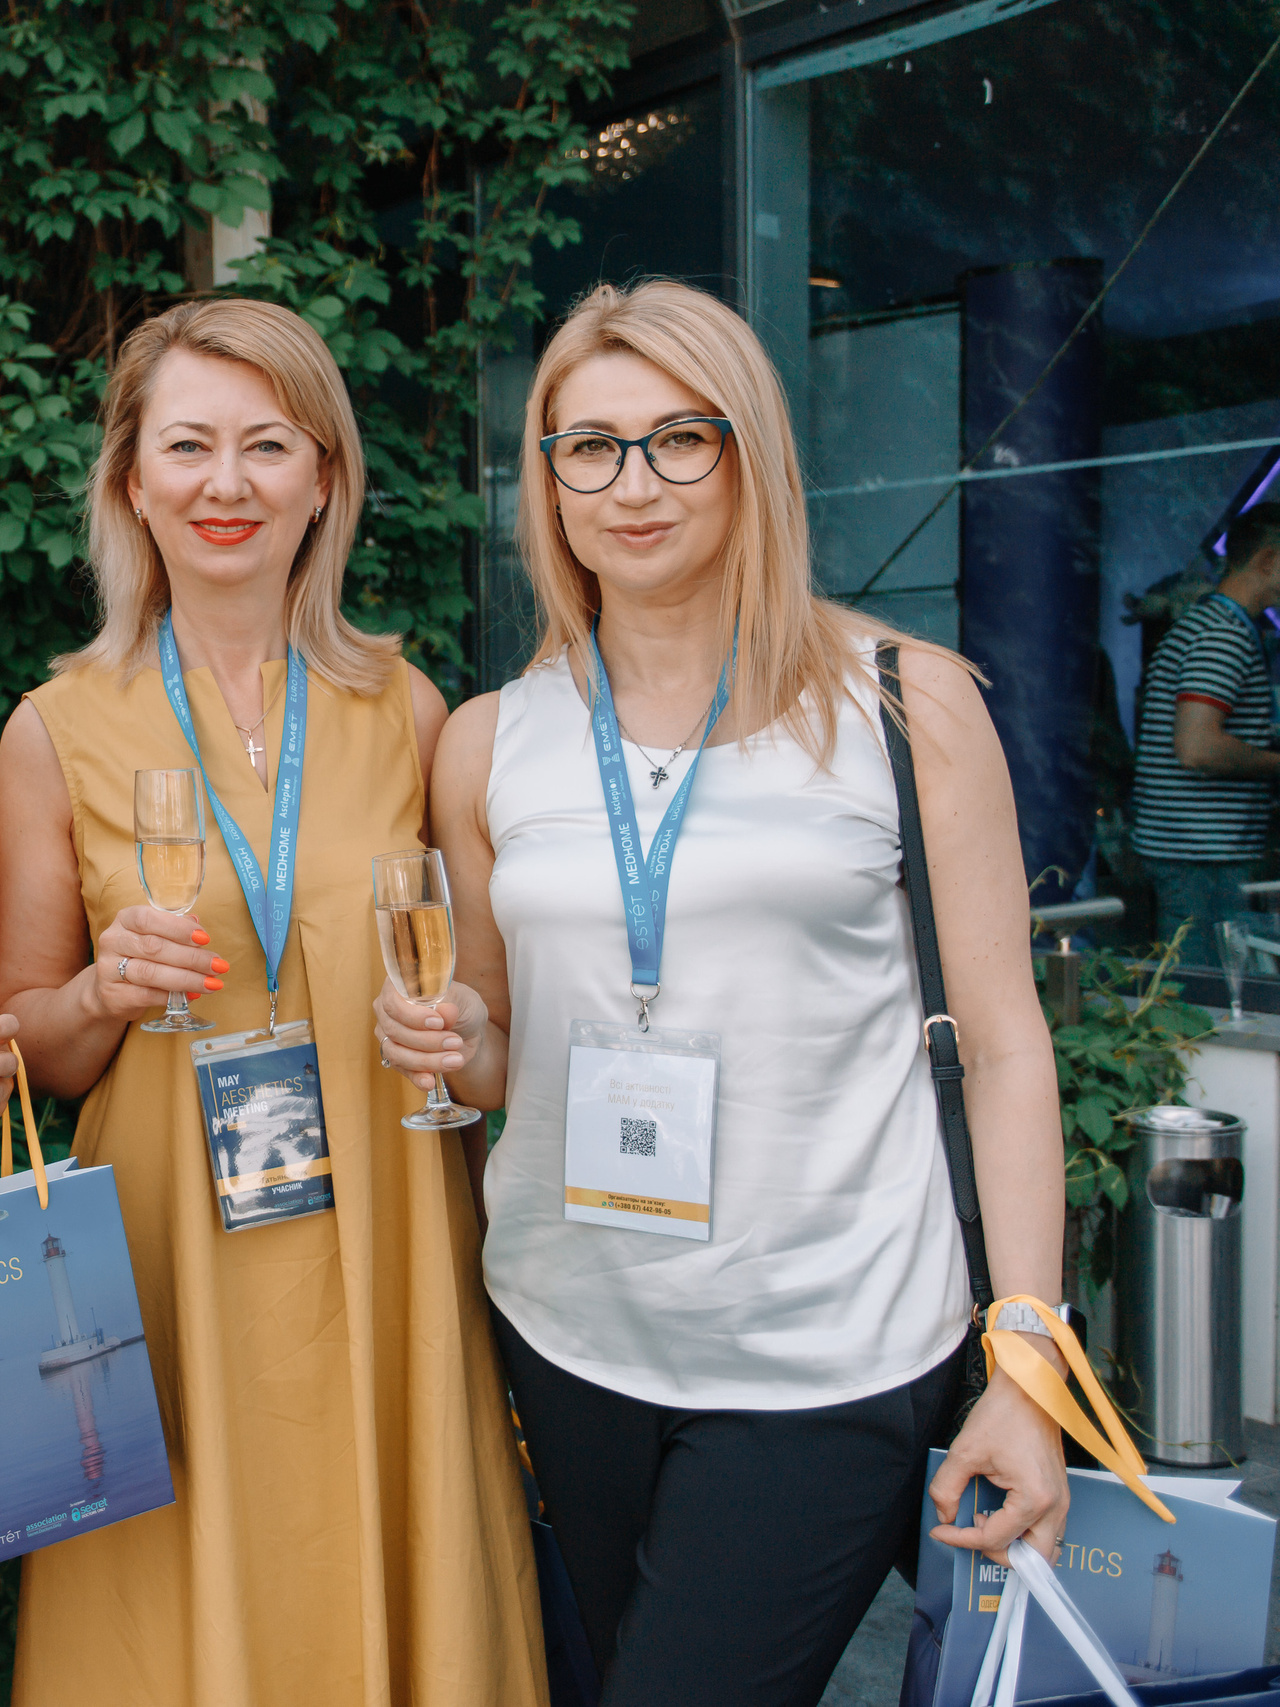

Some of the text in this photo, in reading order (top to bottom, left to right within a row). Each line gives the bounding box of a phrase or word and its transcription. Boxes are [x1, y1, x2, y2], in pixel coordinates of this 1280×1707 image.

[290, 680, 298, 702] EURO
[279, 778, 291, 818] Asclepion
[610, 778, 622, 816] Asclepion
[276, 827, 290, 891] MEDHOME
[618, 822, 640, 884] MEDHOME
[218, 1074, 240, 1088] MAY
[222, 1076, 302, 1106] AESTHETICS
[610, 1079, 671, 1094] Всі активності
[223, 1101, 268, 1118] MEETING
[640, 1099, 674, 1112] додатку
[272, 1182, 303, 1194] УЧАСНИК
[80, 1498, 108, 1514] secret
[26, 1512, 68, 1532] association
